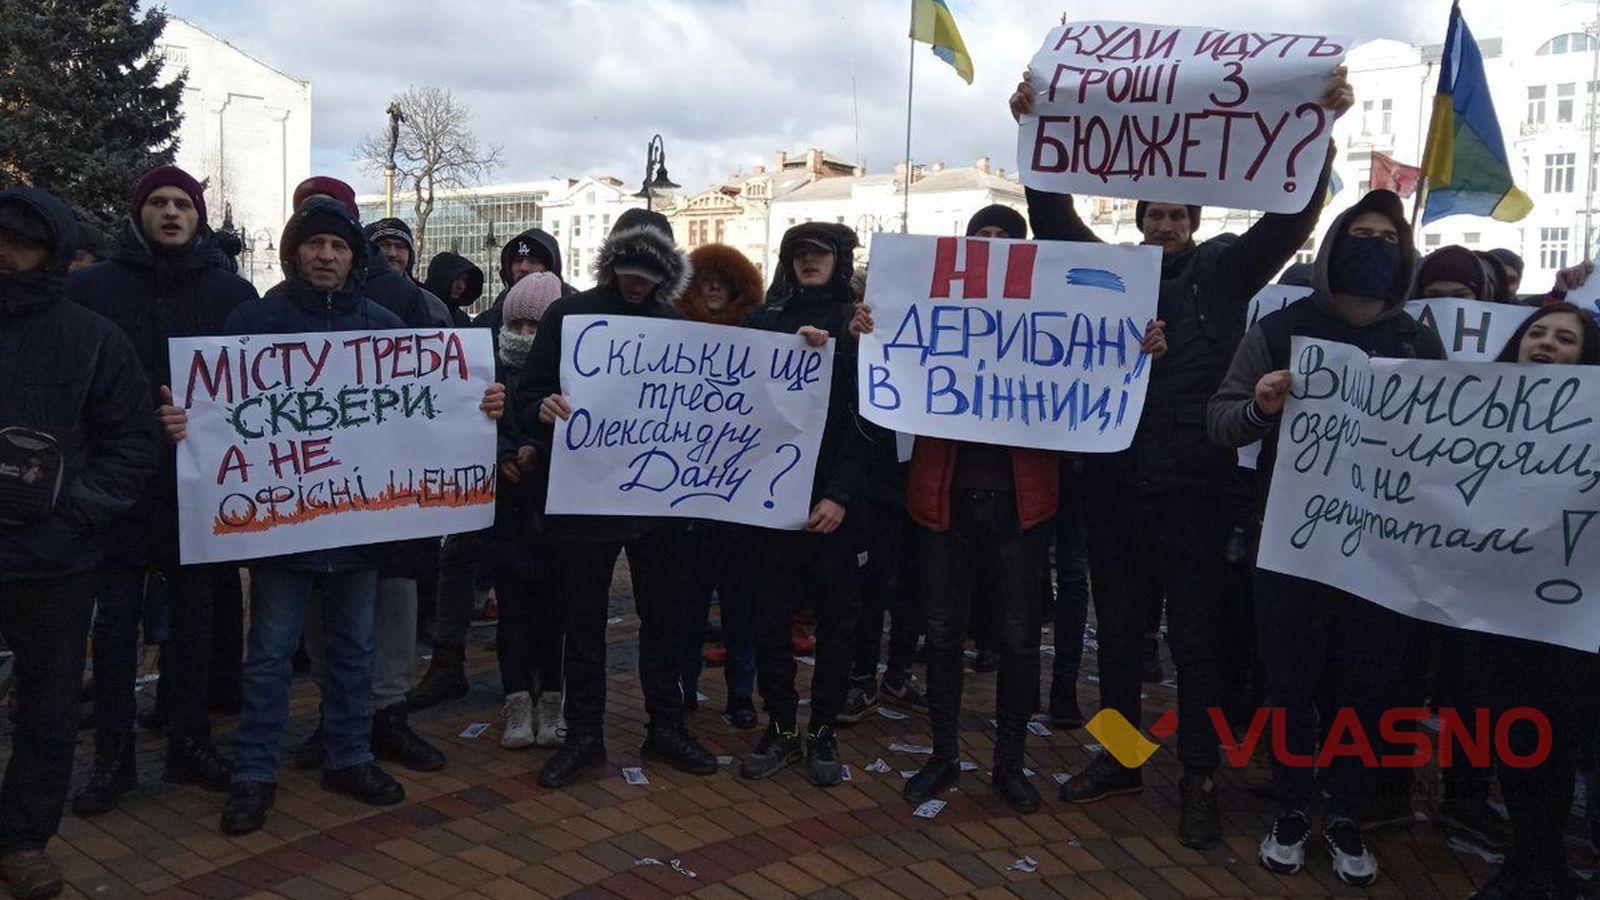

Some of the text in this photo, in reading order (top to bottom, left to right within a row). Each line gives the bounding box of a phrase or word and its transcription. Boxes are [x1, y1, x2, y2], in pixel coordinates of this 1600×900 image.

[1053, 24, 1345, 63] КУДИ ЙДУТЬ
[1048, 60, 1250, 108] ГРОШІ З
[1030, 102, 1326, 193] БЮДЖЕТУ?
[929, 236, 1038, 299] НІ
[184, 330, 469, 409] МІСТУ ТРЕБА
[572, 319, 823, 391] Скільки ще
[225, 382, 442, 445] СКВЕРИ
[637, 376, 754, 422] треба
[868, 358, 1132, 434] В ВІННИЦІ
[216, 436, 342, 486] А НЕ
[565, 407, 762, 469] Олександру
[1351, 463, 1416, 504] а не
